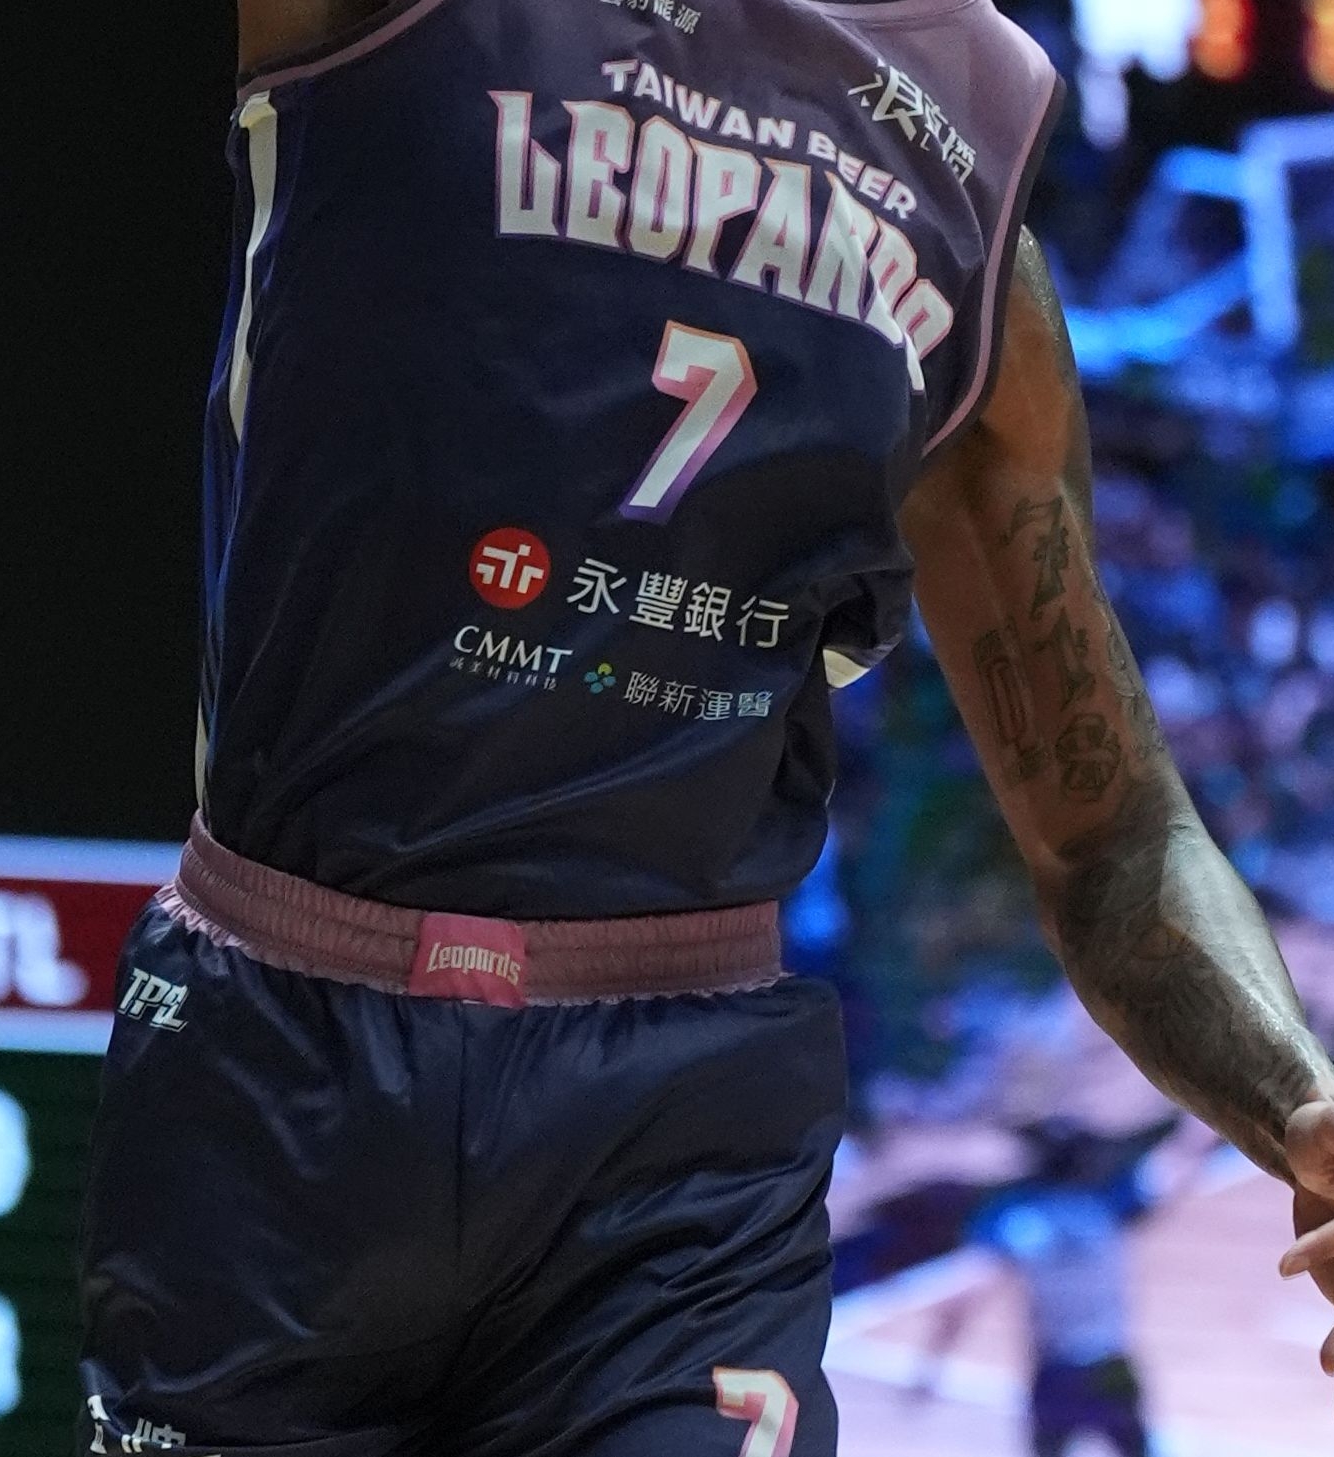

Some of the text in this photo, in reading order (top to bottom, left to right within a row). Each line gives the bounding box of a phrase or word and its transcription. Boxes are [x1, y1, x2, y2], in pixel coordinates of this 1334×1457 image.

[602, 59, 918, 221] TAIWAN BEER
[619, 319, 759, 525] 7
[567, 557, 789, 649] 永豐銀行
[454, 625, 573, 674] CMMT
[624, 671, 773, 722] 聯新運醫
[712, 1366, 800, 1457] 7
